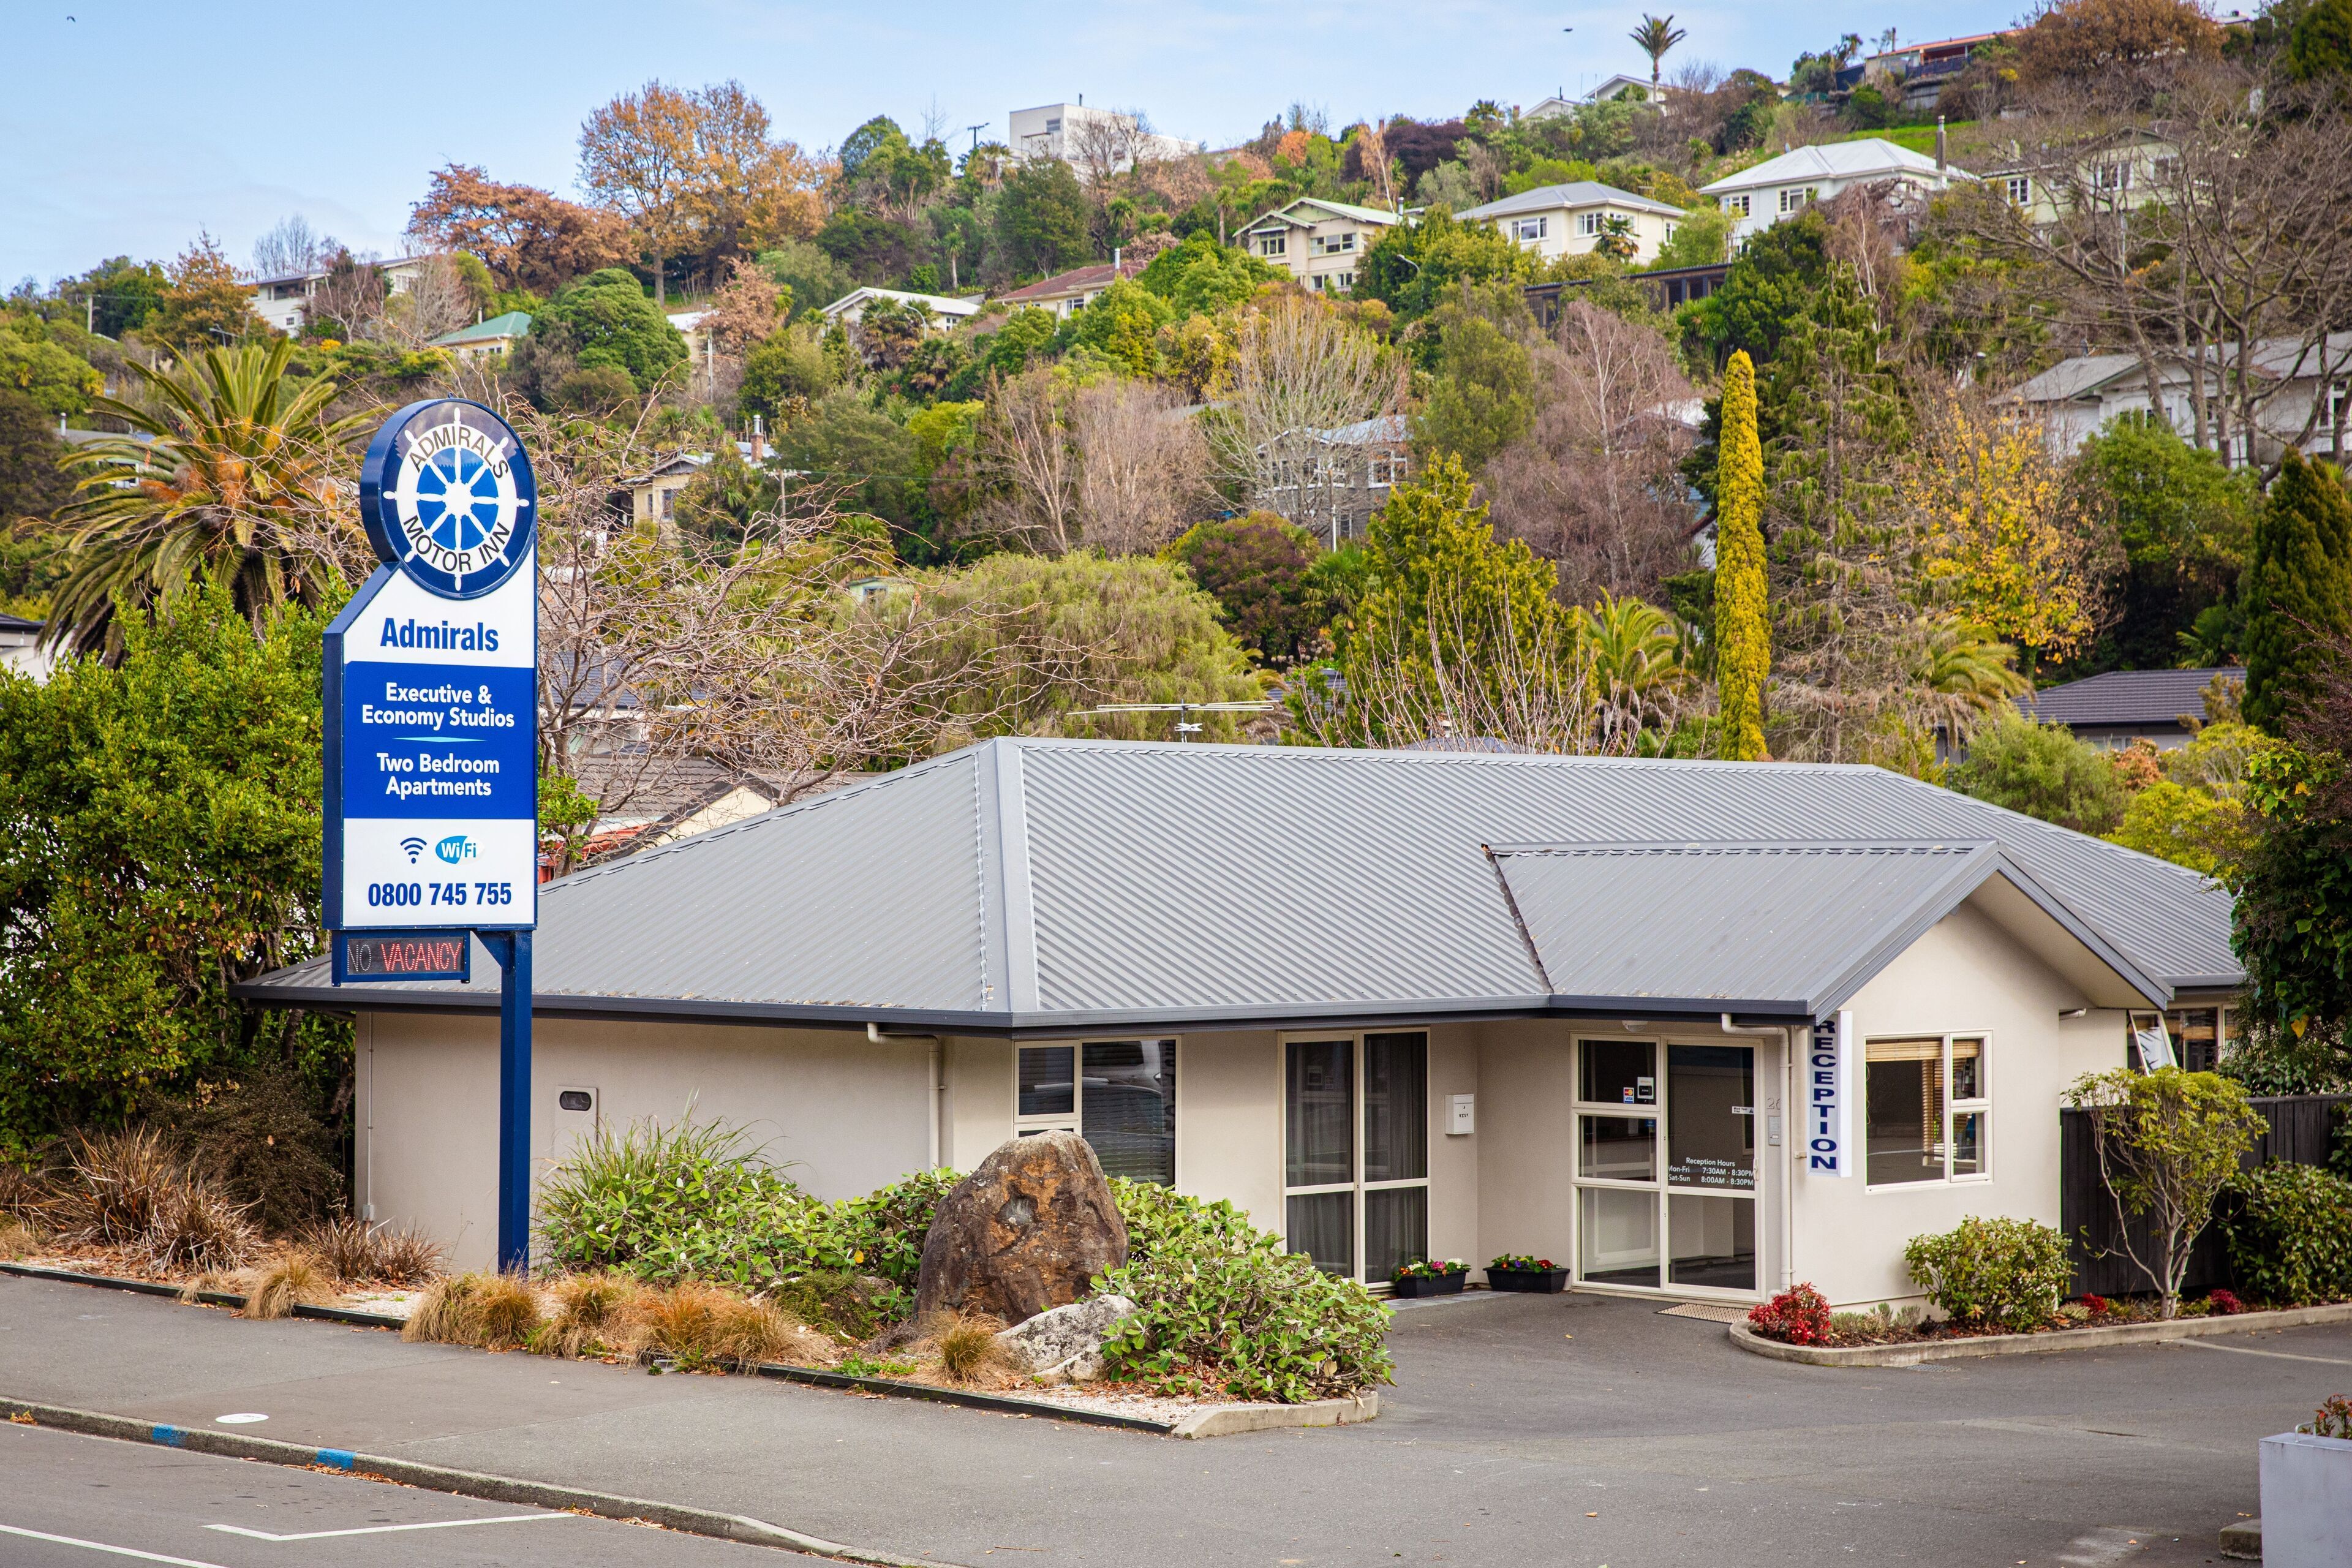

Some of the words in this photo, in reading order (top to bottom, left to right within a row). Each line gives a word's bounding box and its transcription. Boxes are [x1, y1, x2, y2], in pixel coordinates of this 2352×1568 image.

[409, 426, 508, 479] ADMIRALS
[404, 515, 472, 571] MOTOR
[479, 522, 511, 564] INN
[380, 617, 499, 652] Admirals
[386, 682, 472, 704] Executive
[478, 685, 492, 704] &
[362, 704, 444, 731] Economy
[450, 707, 514, 727] Studios
[377, 753, 413, 772] Two
[420, 753, 500, 773] Bedroom
[386, 776, 491, 800] Apartments
[441, 842, 477, 858] WiFi
[368, 883, 422, 907] 0800
[429, 883, 467, 905] 745
[475, 883, 511, 905] 755
[347, 944, 372, 971] NO
[381, 943, 462, 971] VACANCY
[1811, 1020, 1837, 1170] RECEPTION
[1686, 1157, 1716, 1166] Reception
[1702, 1167, 1726, 1175] 7:30AM
